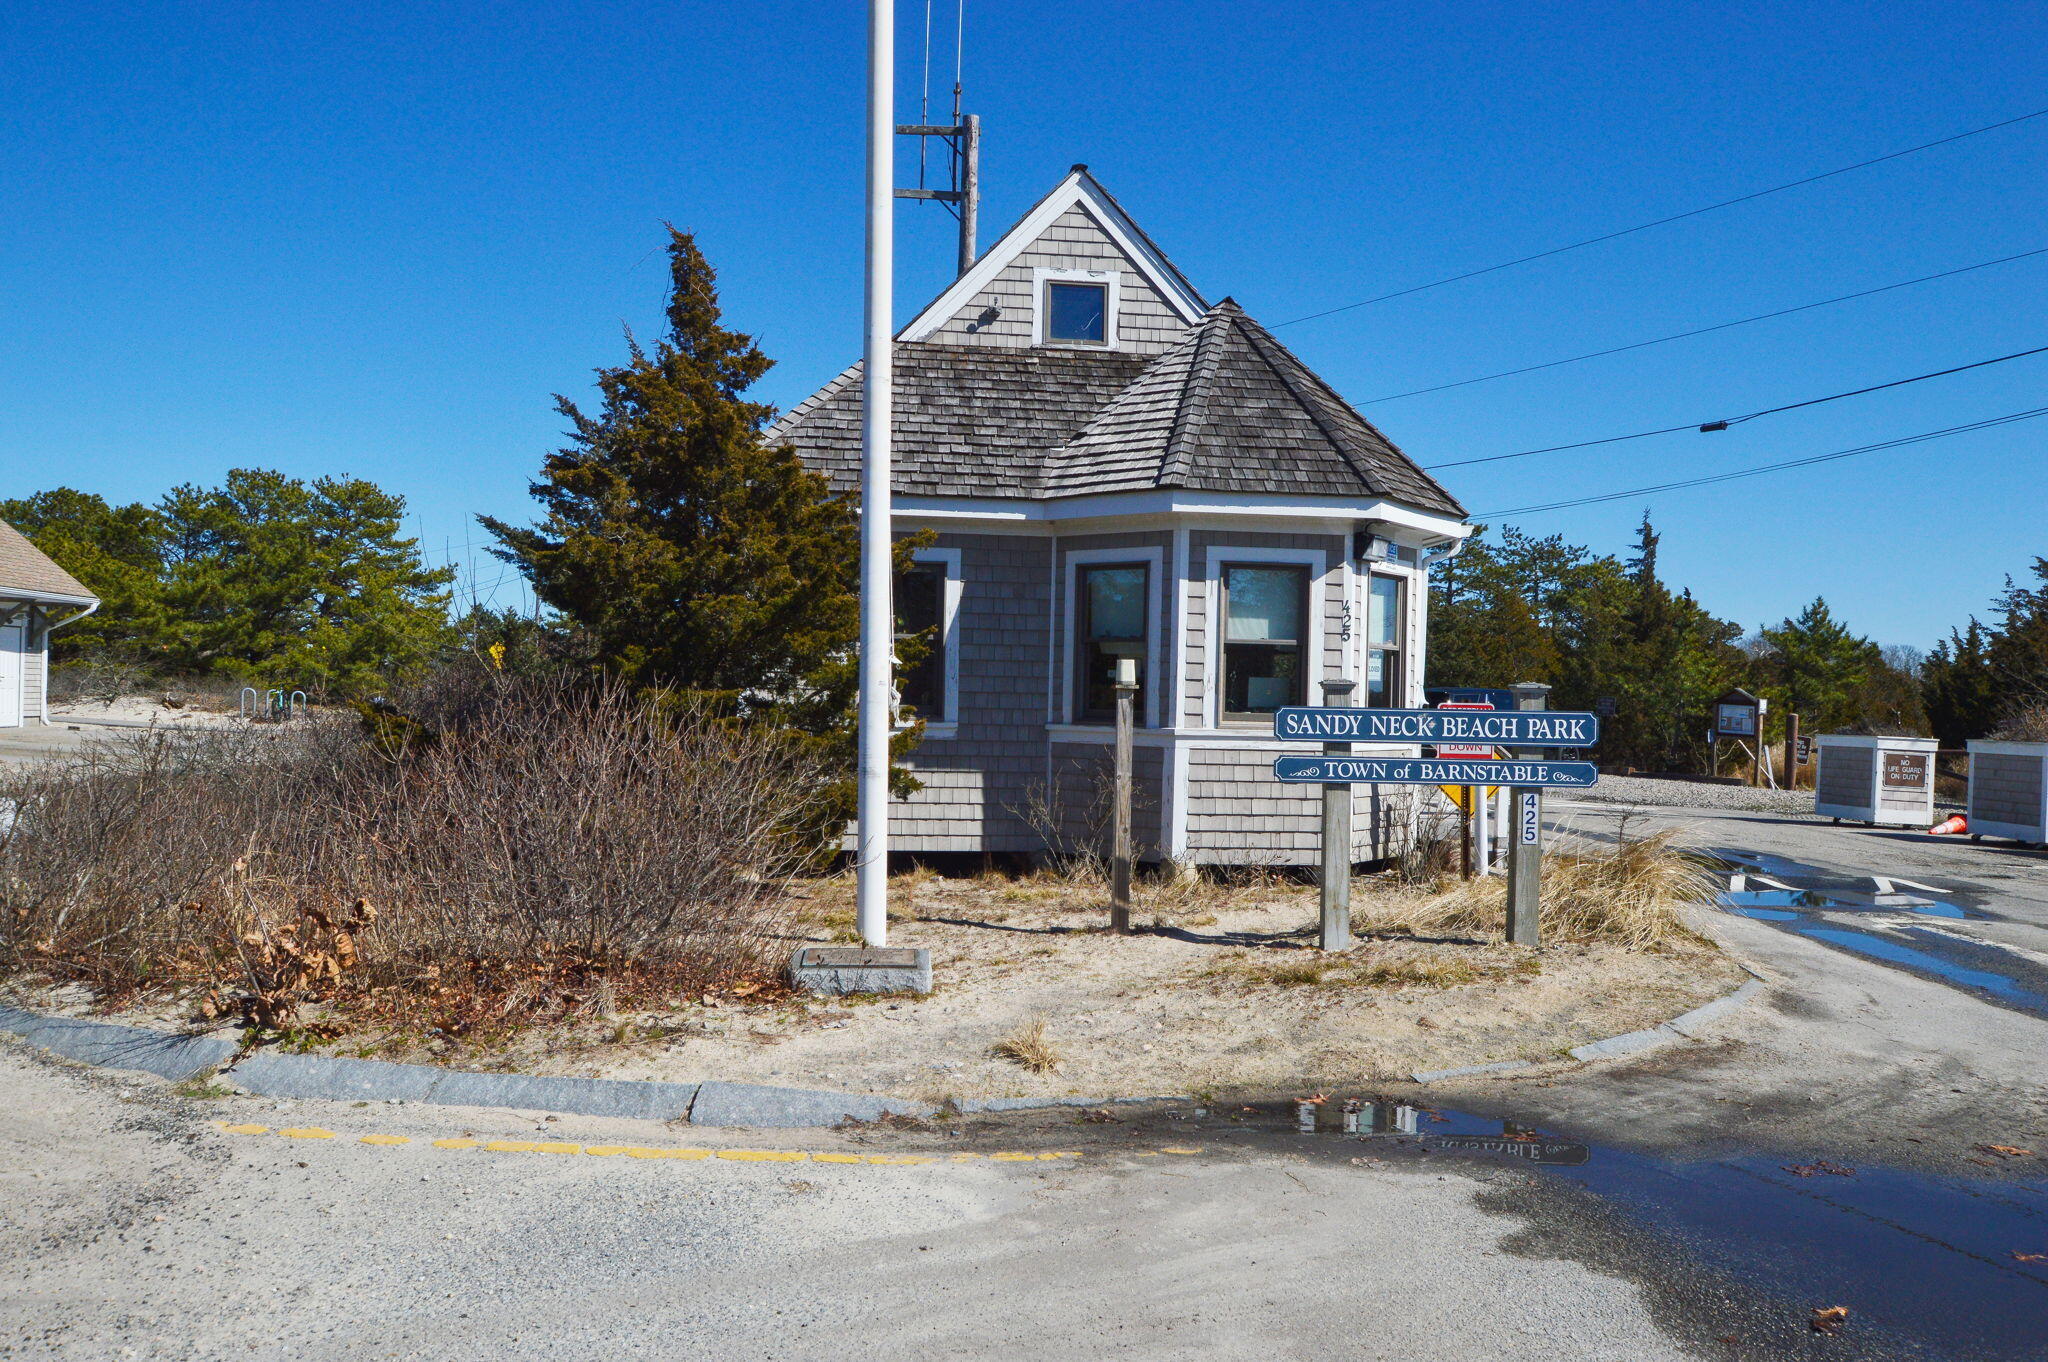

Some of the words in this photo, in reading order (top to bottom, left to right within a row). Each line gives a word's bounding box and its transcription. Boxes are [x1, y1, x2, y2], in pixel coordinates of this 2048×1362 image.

[1341, 599, 1352, 643] 425
[1286, 713, 1363, 735] SANDY
[1370, 715, 1434, 737] NECK
[1441, 717, 1518, 738] BEACH
[1527, 718, 1586, 740] PARK
[1324, 762, 1388, 779] TOWN
[1393, 763, 1412, 779] of
[1420, 764, 1549, 782] BARNSTABLE
[1887, 765, 1900, 773] LIFE
[1901, 766, 1922, 774] GUARD
[1890, 772, 1900, 780] ON
[1524, 794, 1537, 841] 425
